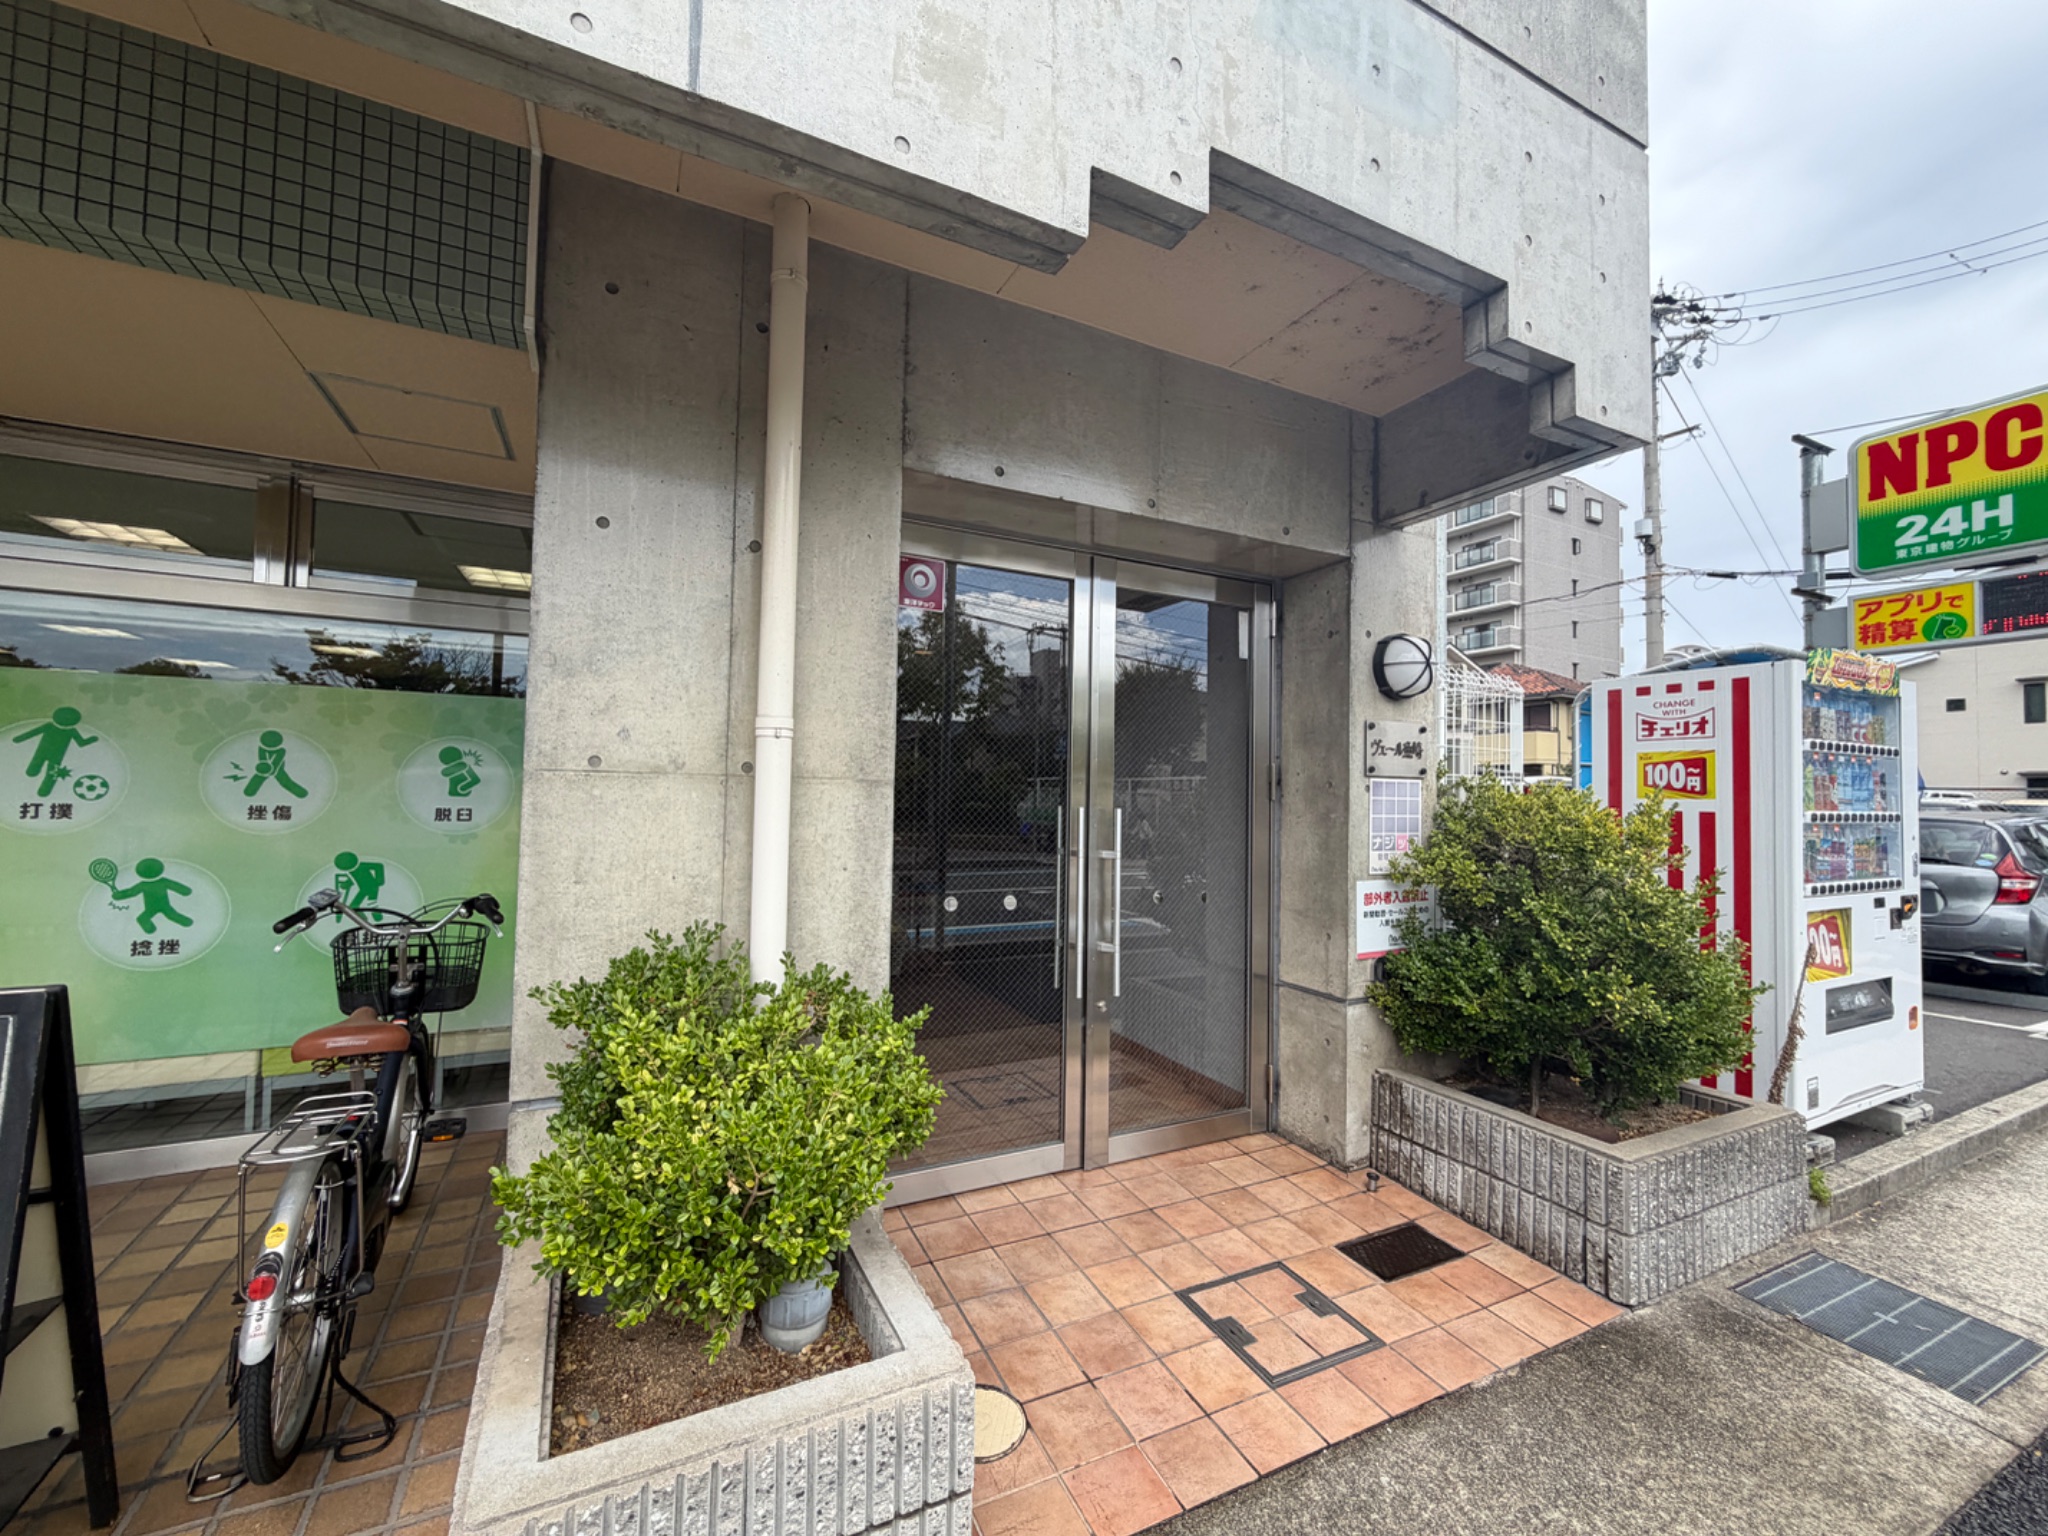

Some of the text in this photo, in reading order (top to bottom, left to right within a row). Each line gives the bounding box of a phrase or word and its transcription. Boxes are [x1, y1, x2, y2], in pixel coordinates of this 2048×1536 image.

[1867, 403, 2043, 502] NPC
[1894, 494, 2014, 547] 24H
[1894, 528, 2013, 560] 東京建物グループ
[1857, 591, 1964, 622] アプリで
[1857, 618, 1918, 646] 精算
[1653, 698, 1696, 709] CHANGE
[1661, 708, 1687, 717] WITH
[1641, 716, 1709, 738] チェリオ
[19, 802, 74, 821] 打撲
[247, 804, 292, 822] 挫傷
[433, 806, 473, 823] 脱臼
[129, 938, 181, 957] 捻挫
